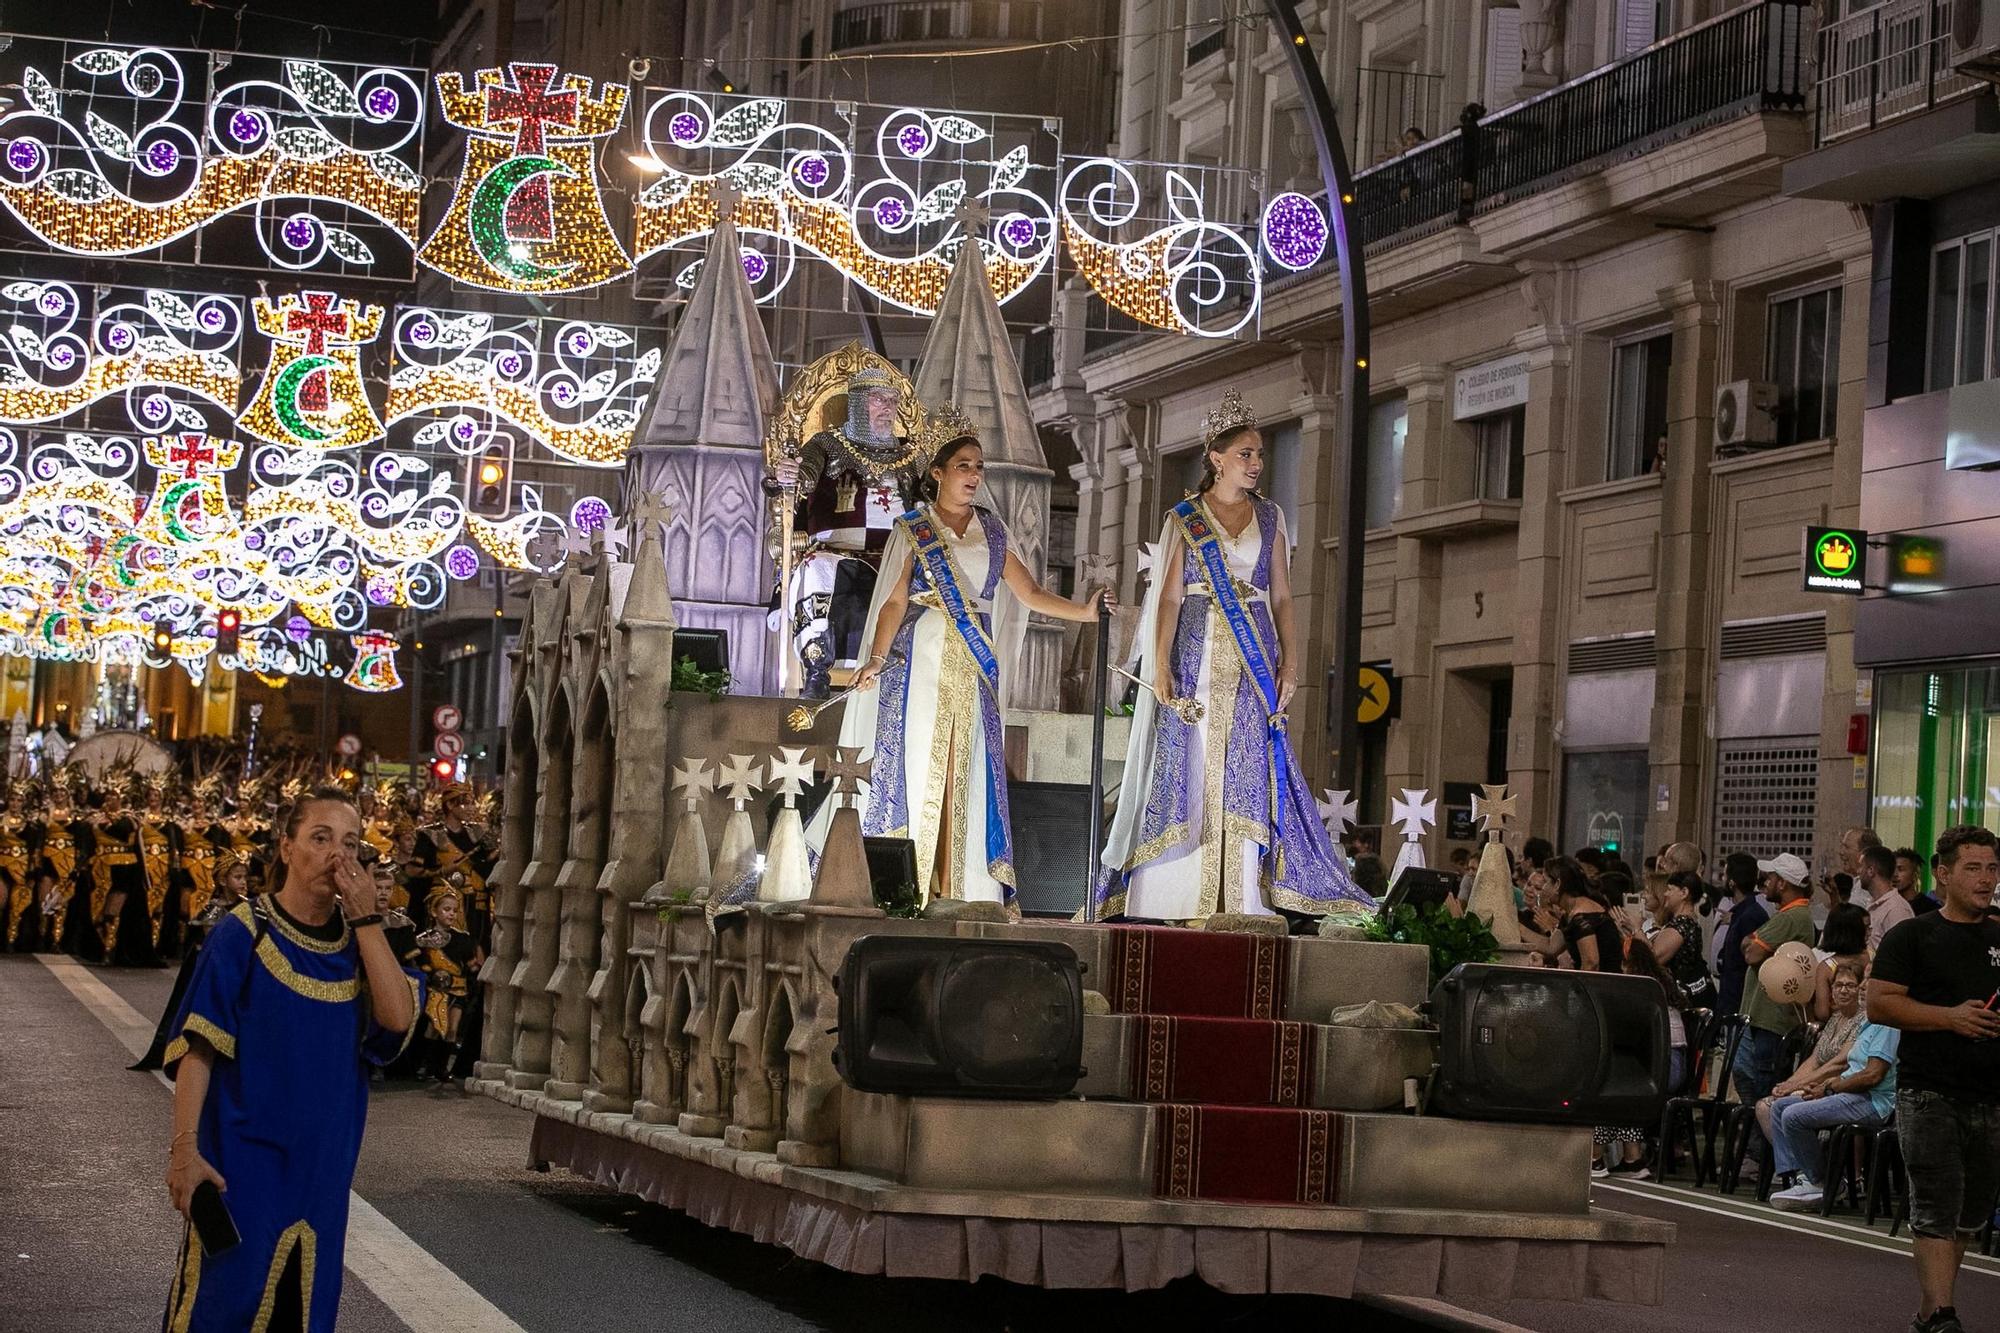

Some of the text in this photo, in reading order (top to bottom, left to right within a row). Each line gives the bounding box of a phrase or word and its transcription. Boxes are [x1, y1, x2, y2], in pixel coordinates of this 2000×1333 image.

[1494, 384, 1515, 401] MURCIA
[963, 624, 994, 666] Infantil
[1230, 610, 1257, 663] Fernando
